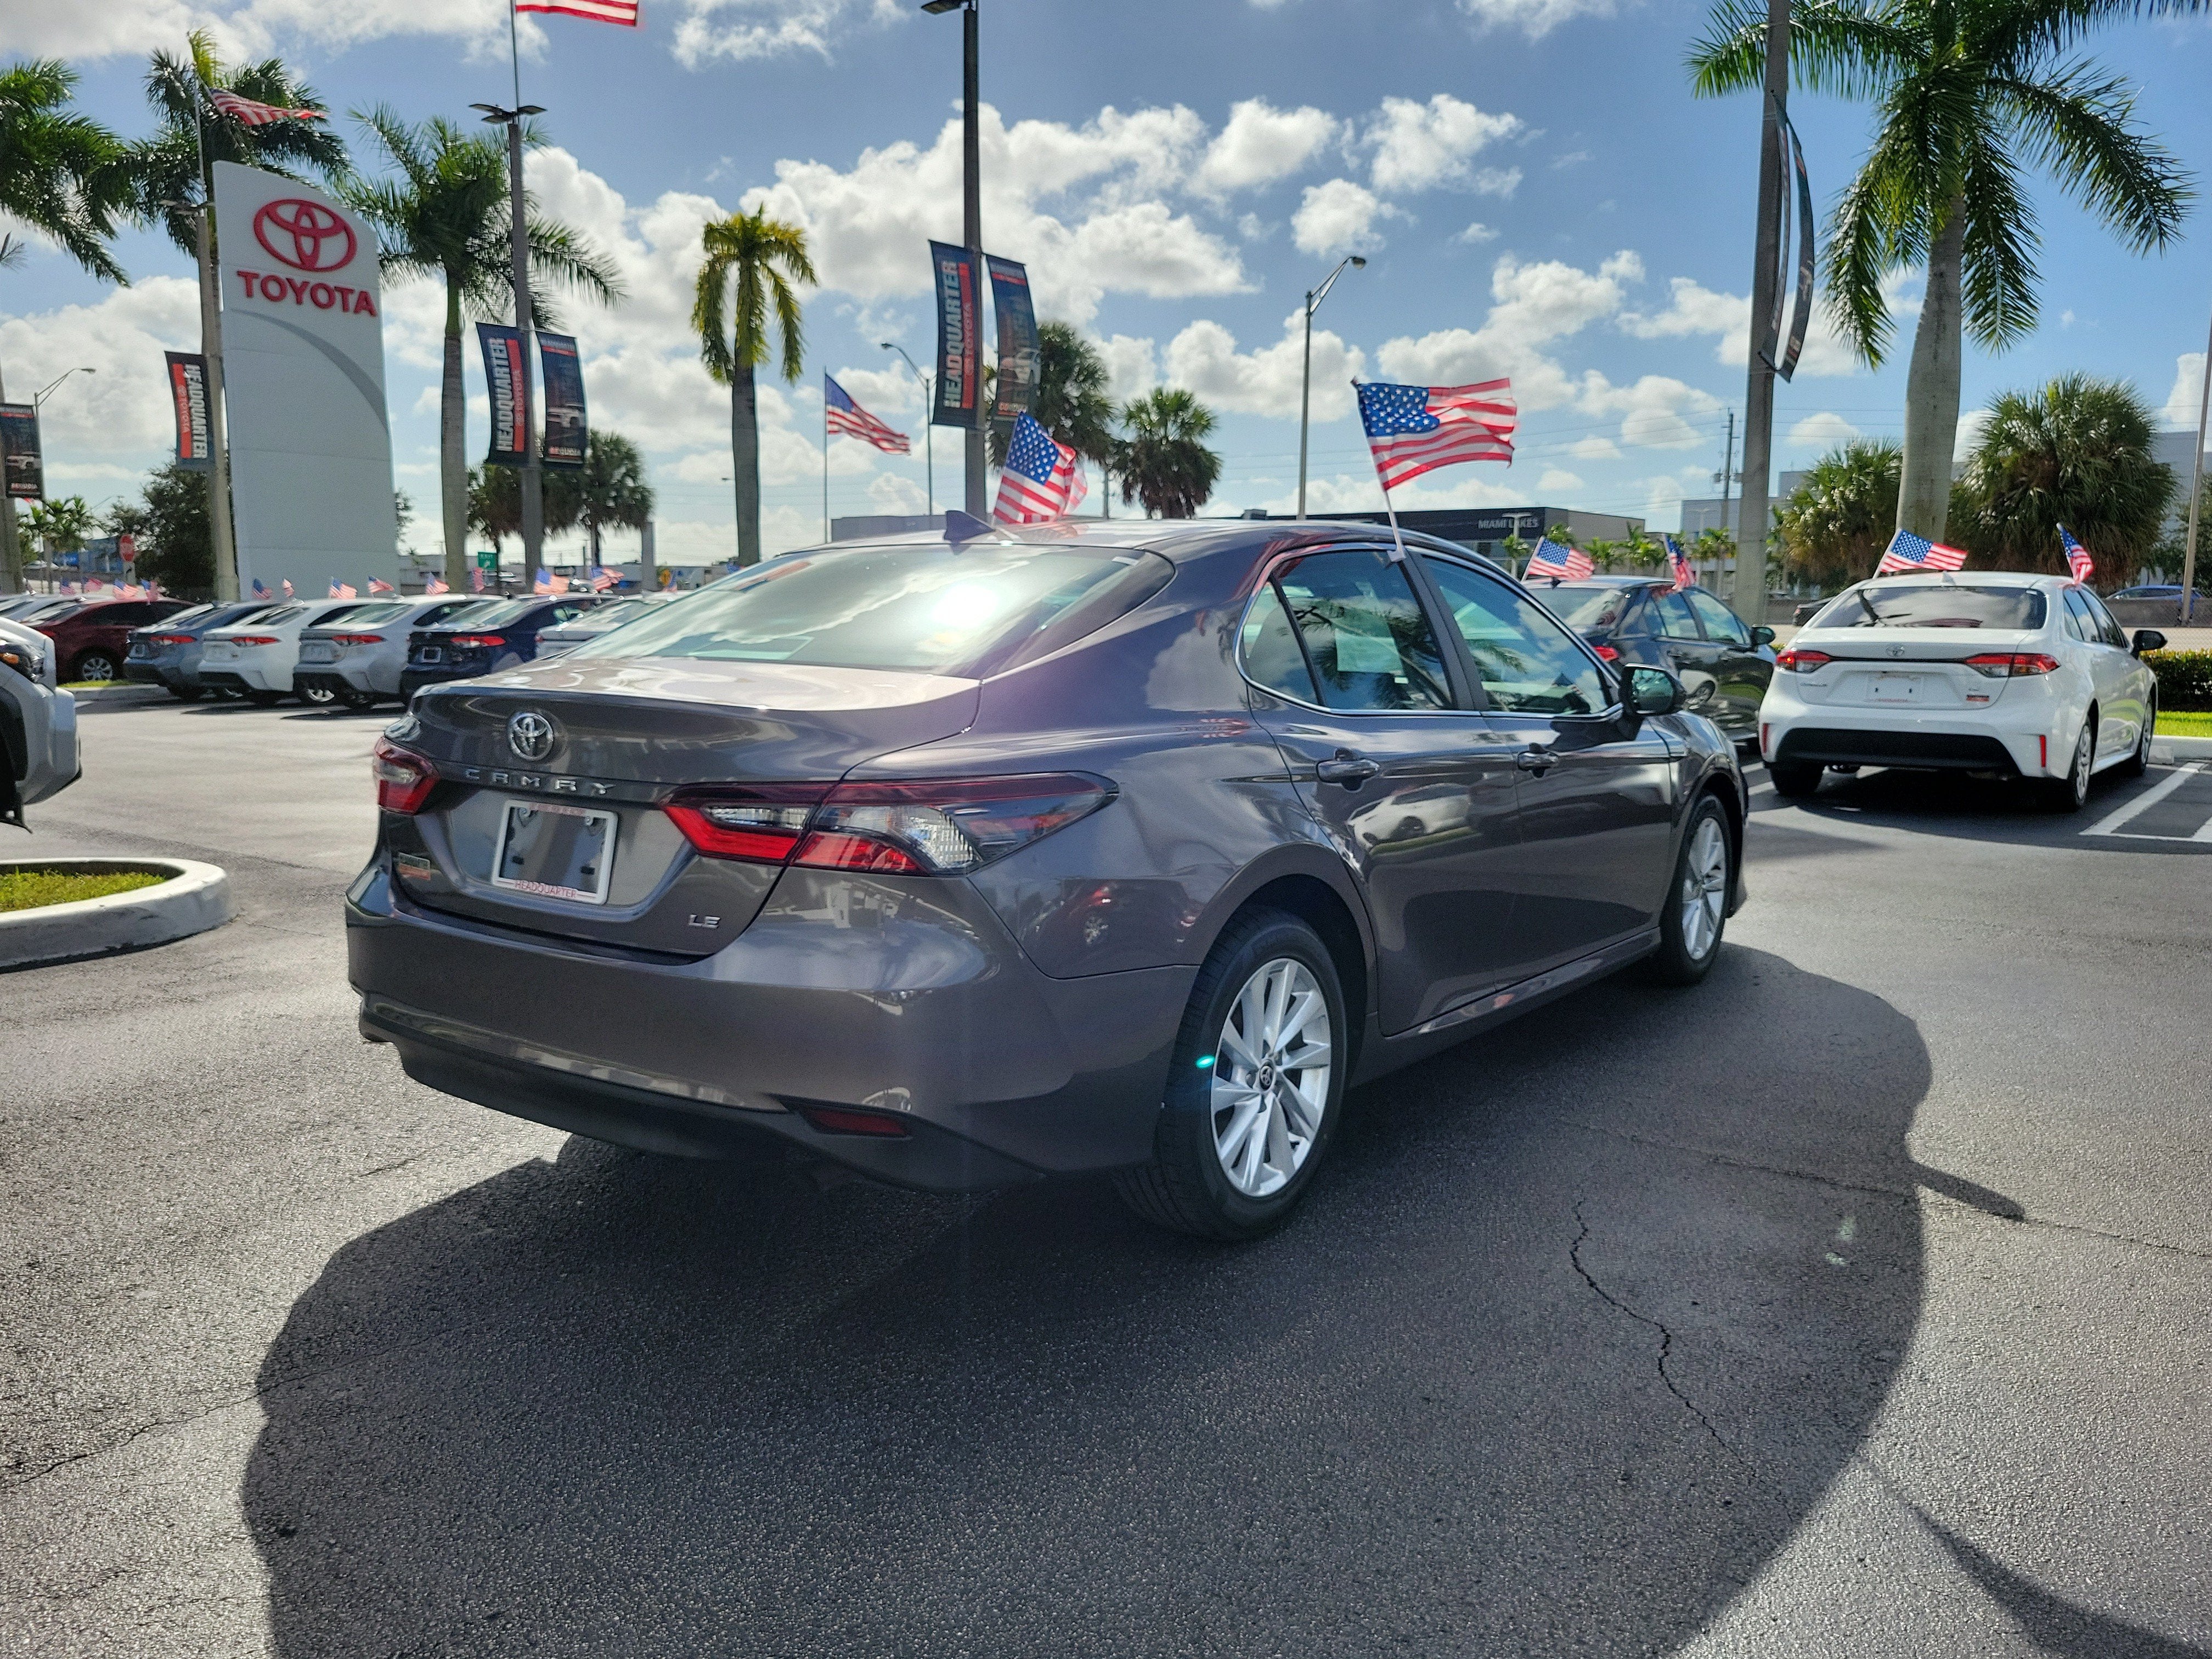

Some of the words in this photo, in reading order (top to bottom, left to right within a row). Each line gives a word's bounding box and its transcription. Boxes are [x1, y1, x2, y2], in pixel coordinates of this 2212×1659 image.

[236, 270, 377, 318] TOYOTA
[941, 261, 963, 408] HEADQUARTER
[184, 364, 208, 459] HEADQUARTER
[488, 338, 514, 452] HEADQUARTER
[1479, 518, 1508, 529] MIAMI
[1508, 517, 1539, 528] LKES
[466, 769, 617, 794] CAMRY
[515, 879, 577, 898] HEADQUARTER
[689, 914, 721, 929] LE
